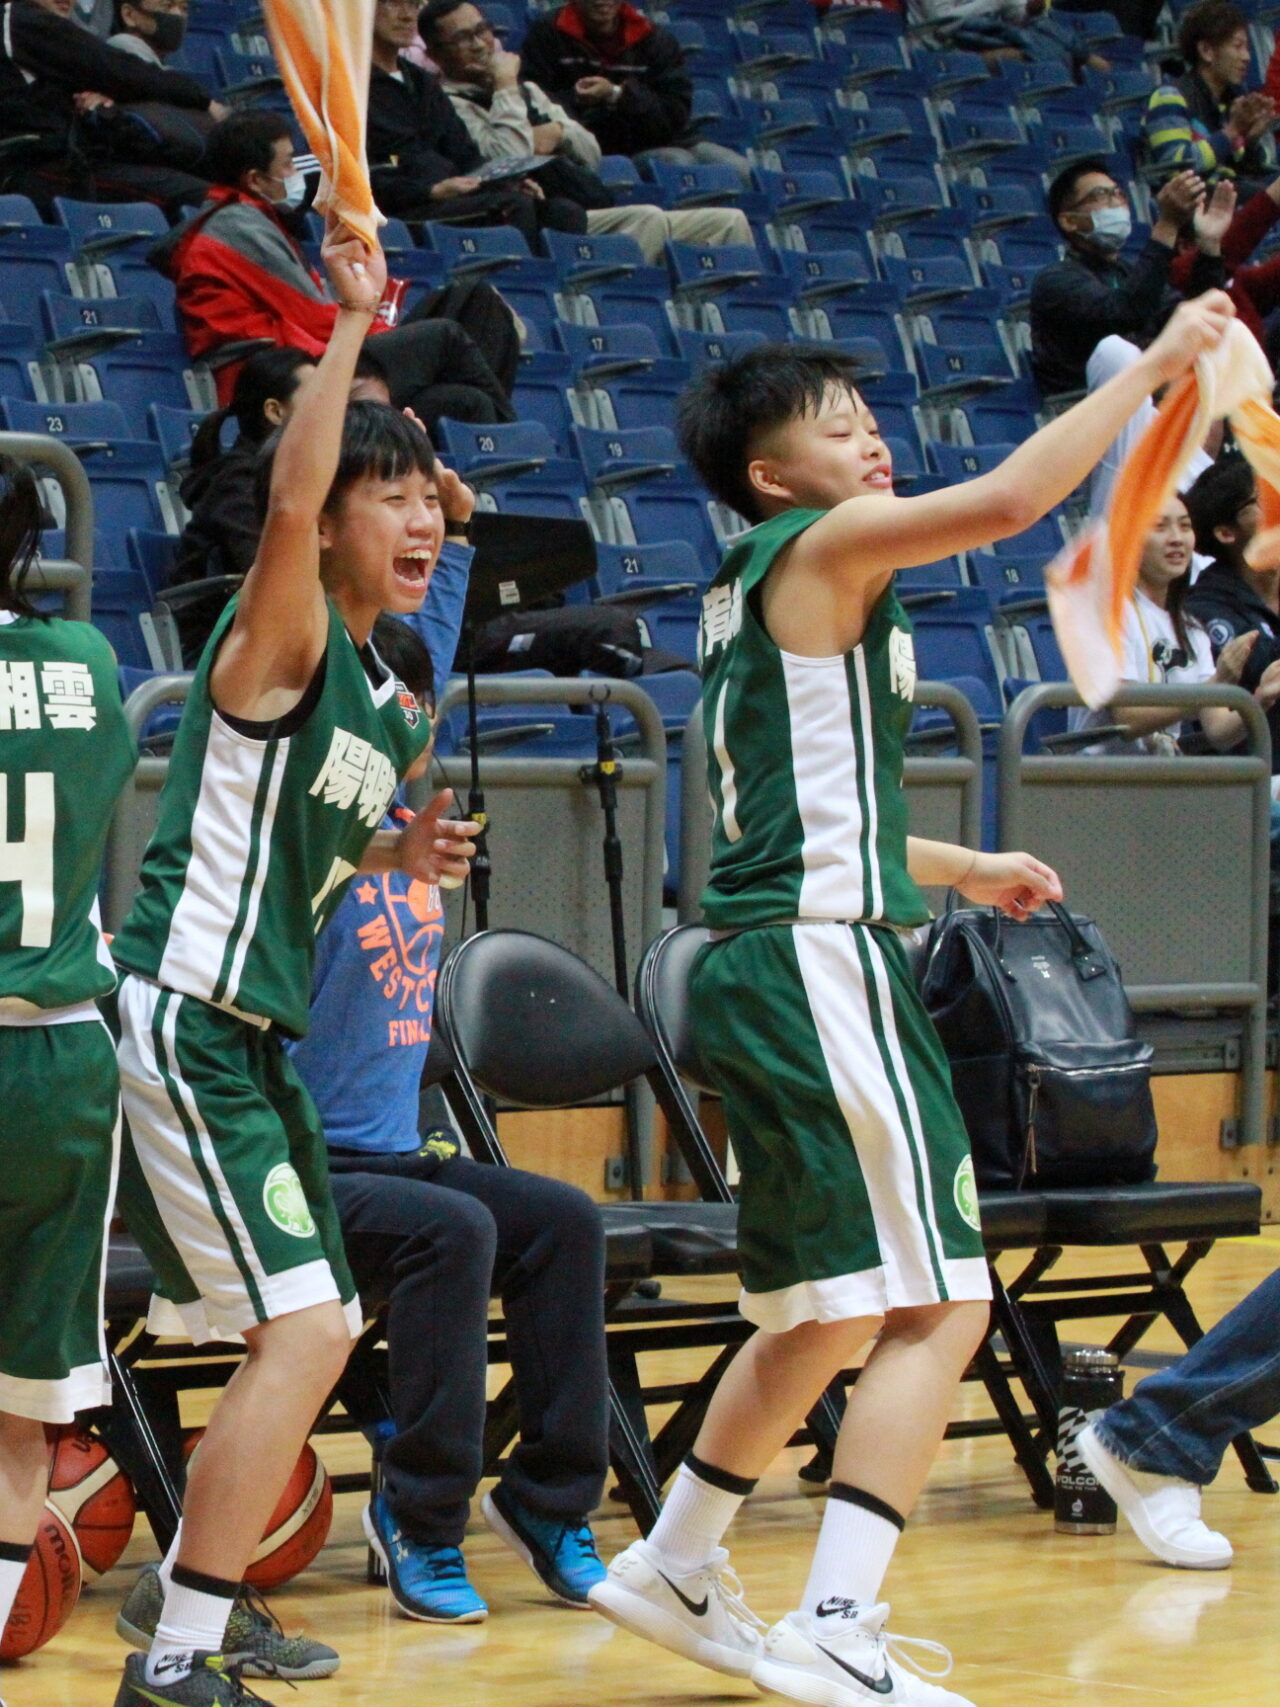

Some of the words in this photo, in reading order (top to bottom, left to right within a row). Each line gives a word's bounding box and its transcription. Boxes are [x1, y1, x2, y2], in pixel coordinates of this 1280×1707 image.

[98, 214, 112, 229] 19
[700, 256, 713, 269] 14
[83, 311, 98, 324] 21
[591, 337, 604, 351] 17
[950, 357, 961, 370] 14
[46, 417, 63, 432] 23
[479, 437, 494, 451] 20
[609, 443, 623, 457] 19
[624, 558, 639, 573] 21
[308, 726, 396, 828] 陽明
